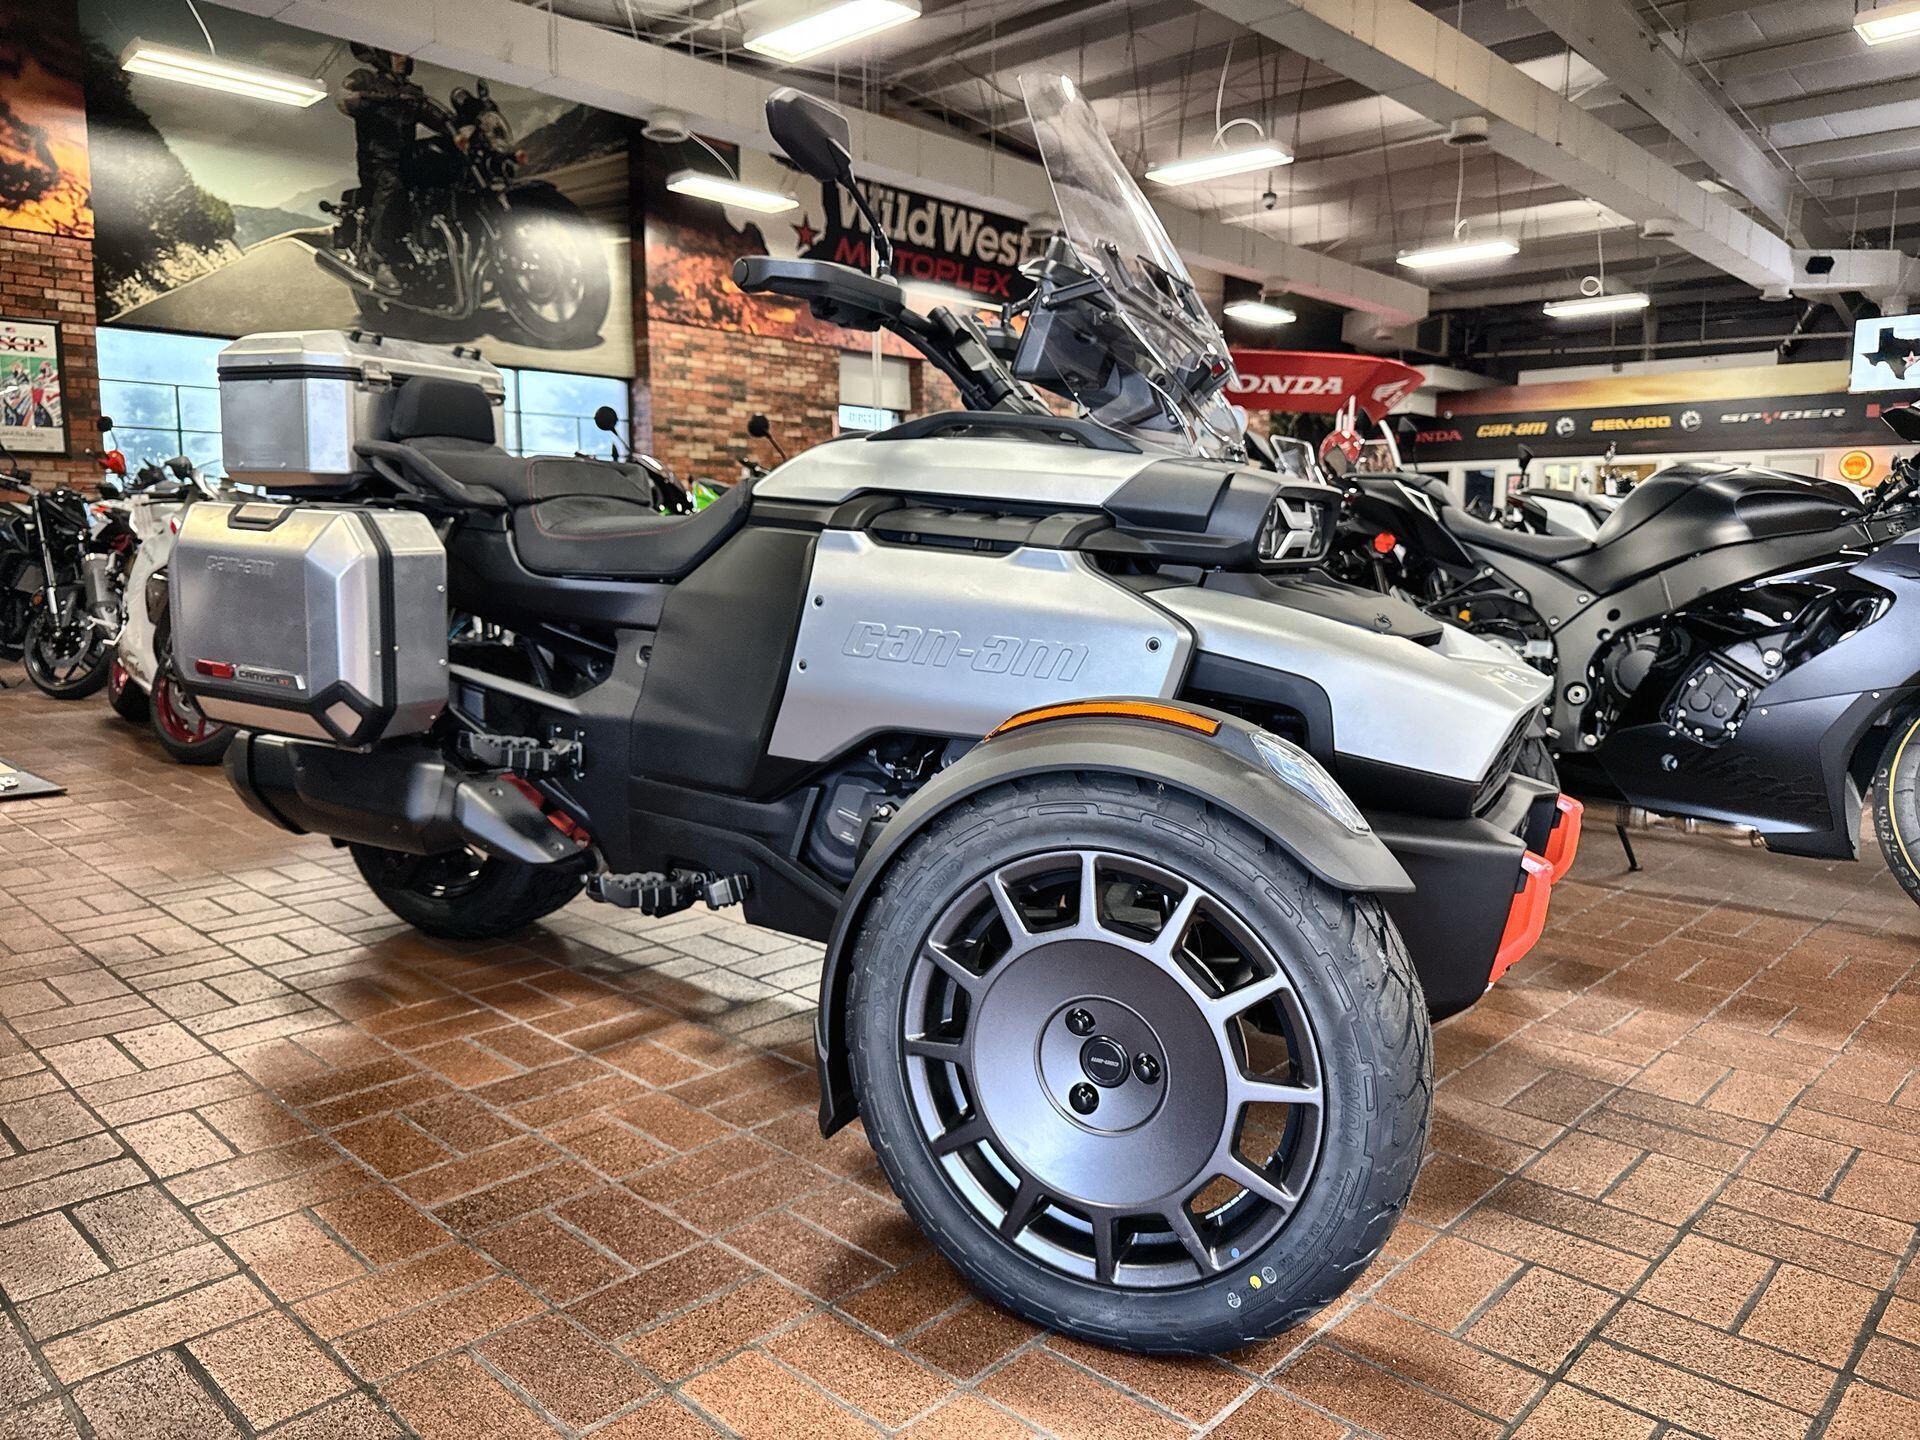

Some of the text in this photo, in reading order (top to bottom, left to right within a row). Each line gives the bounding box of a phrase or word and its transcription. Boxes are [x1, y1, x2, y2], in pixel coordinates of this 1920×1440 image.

[834, 237, 1013, 298] MTOPLEX
[1221, 374, 1344, 395] ONDA
[1719, 407, 1847, 425] SPYDER
[841, 620, 1090, 682] can-am
